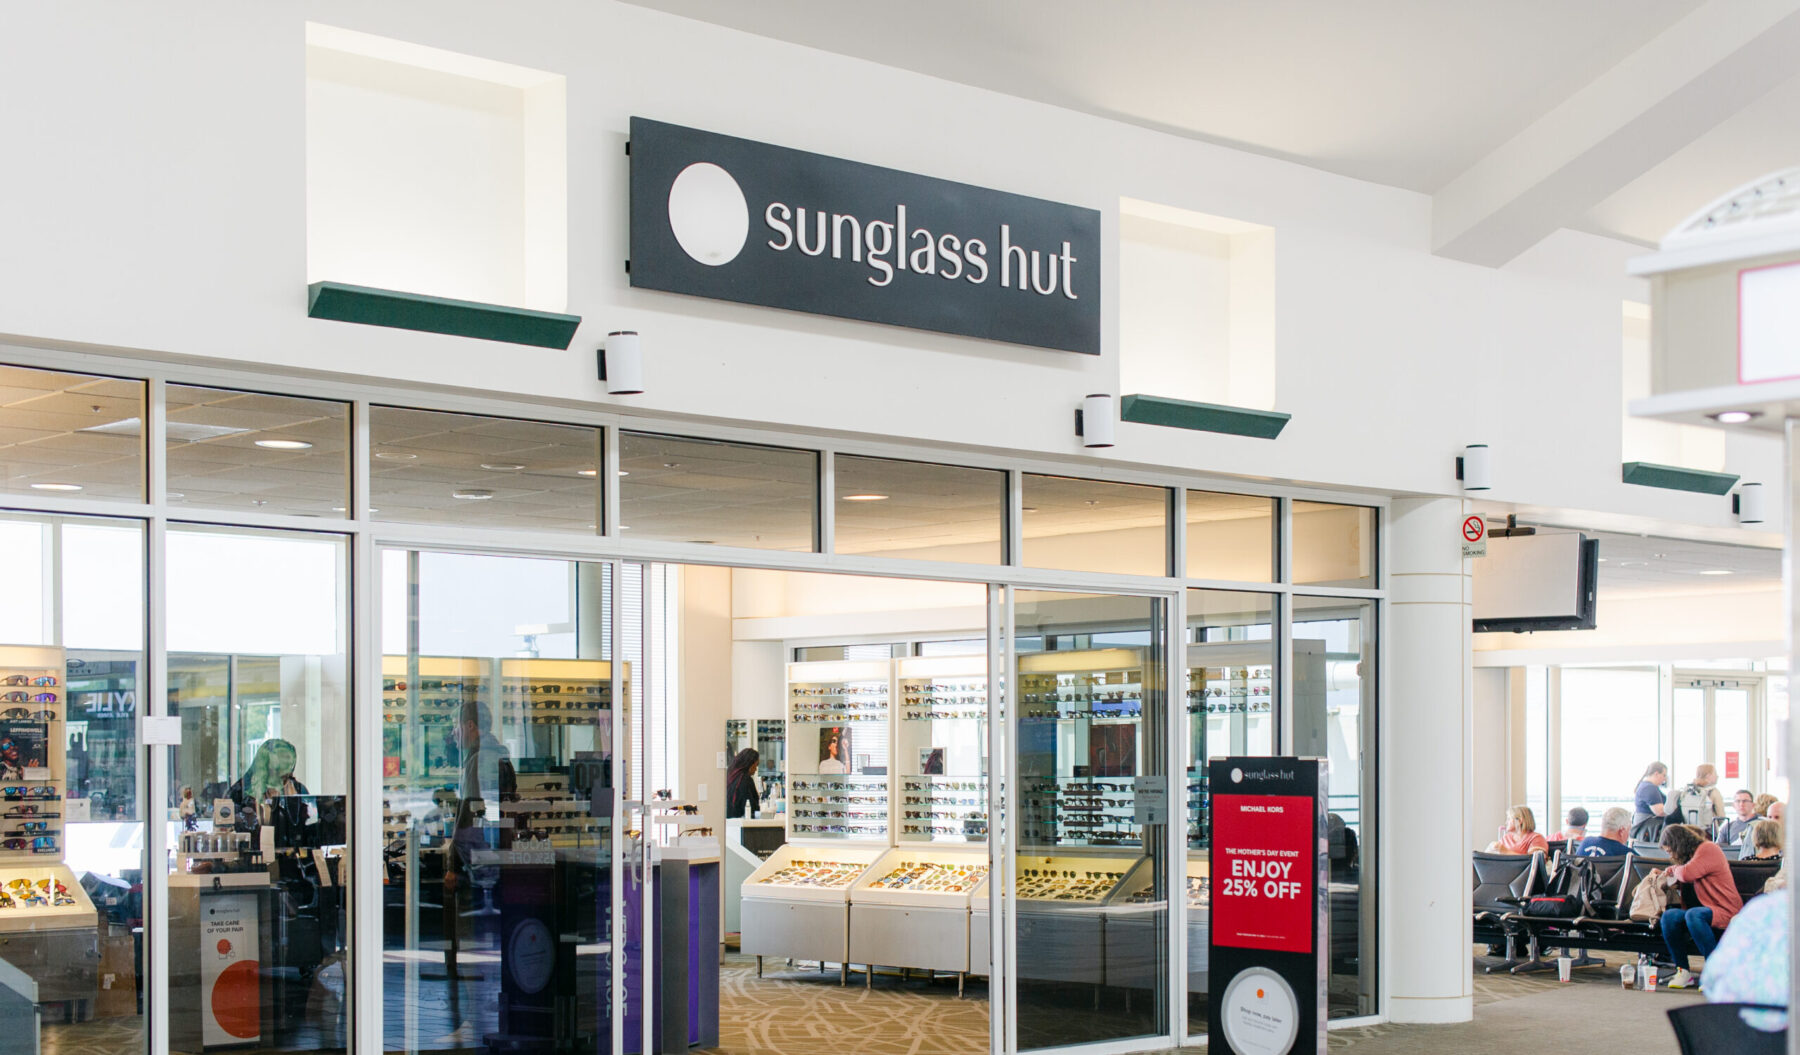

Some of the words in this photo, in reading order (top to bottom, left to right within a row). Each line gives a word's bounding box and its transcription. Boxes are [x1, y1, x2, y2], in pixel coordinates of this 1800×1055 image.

[765, 202, 989, 287] sunglass
[1001, 224, 1078, 300] hut
[1244, 769, 1279, 781] sunglass
[1280, 769, 1295, 780] hut
[1240, 805, 1266, 813] MICHAEL
[1225, 847, 1237, 855] THE
[1237, 848, 1266, 856] MOTHER'S
[1267, 849, 1279, 857] DAY
[1279, 850, 1299, 858] EVENT
[1231, 859, 1293, 879] ENJOY
[1222, 878, 1258, 897] 25%
[1263, 880, 1302, 900] OFF
